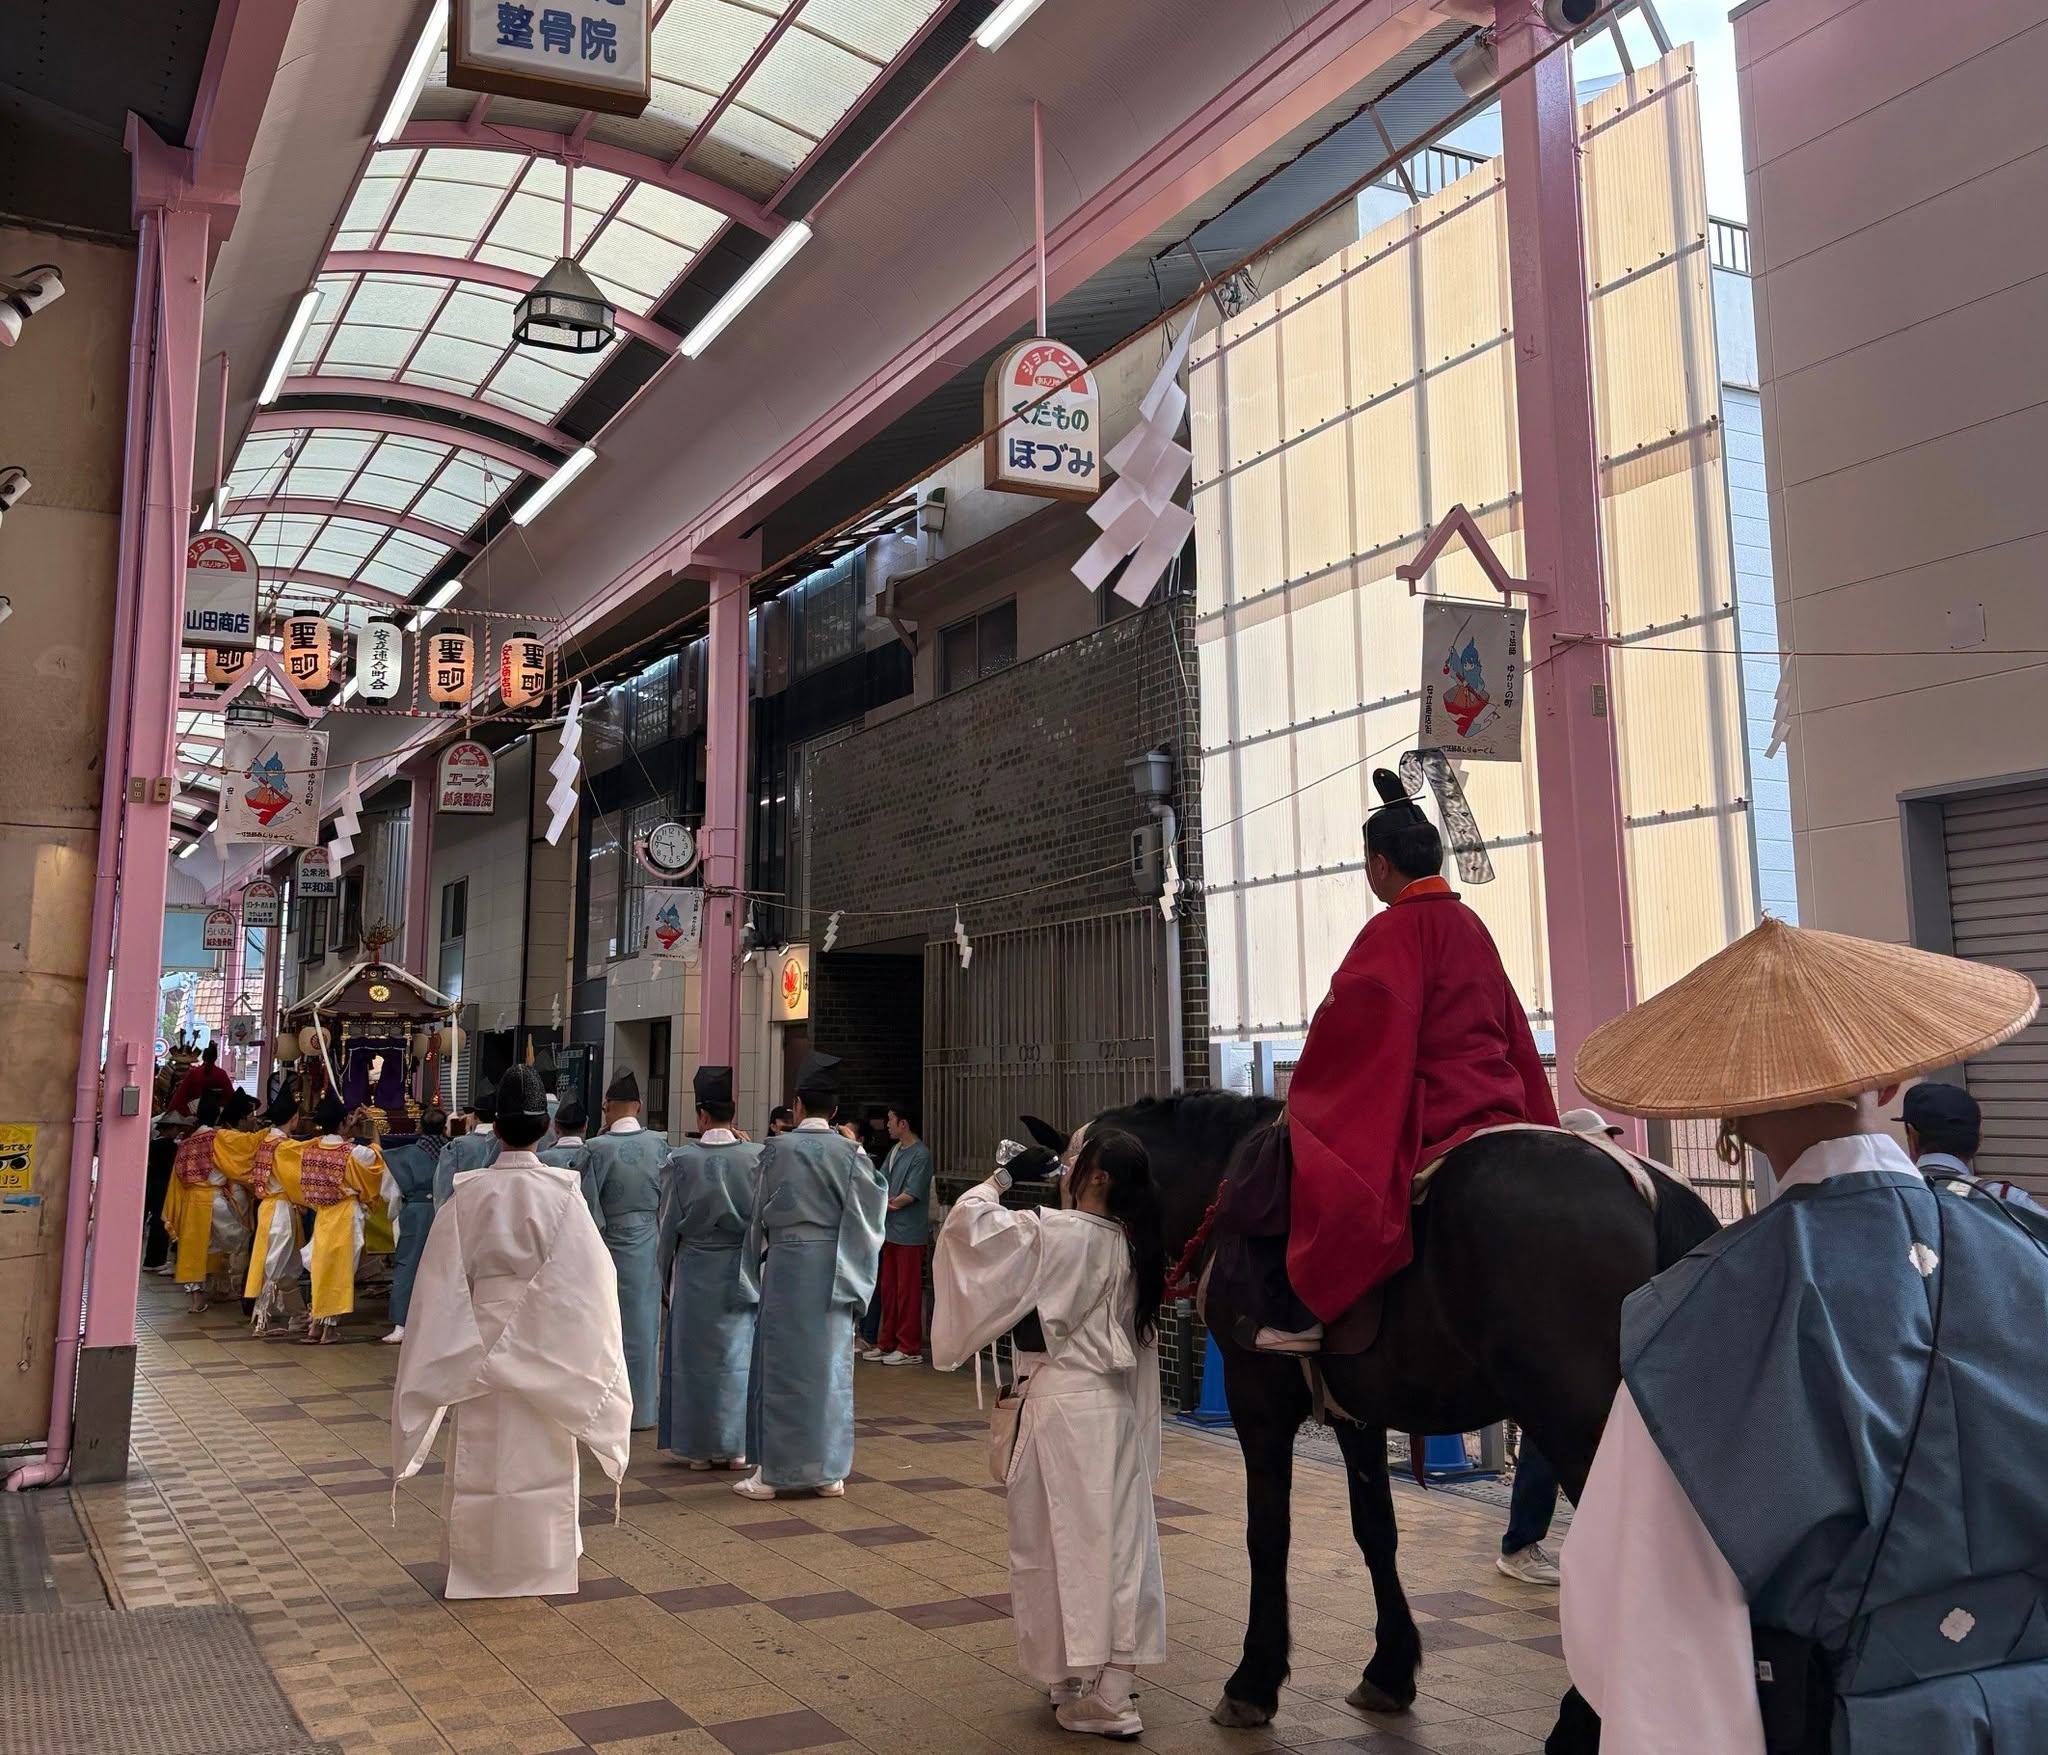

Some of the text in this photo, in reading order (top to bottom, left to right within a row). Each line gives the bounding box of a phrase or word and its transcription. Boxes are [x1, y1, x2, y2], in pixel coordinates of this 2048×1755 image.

[497, 2, 616, 63] 整骨院
[1012, 400, 1089, 431] くだもの
[1009, 438, 1095, 477] ほづみ
[186, 610, 250, 633] 山田商店
[369, 629, 389, 690] 安立連合町会
[447, 773, 490, 787] エース
